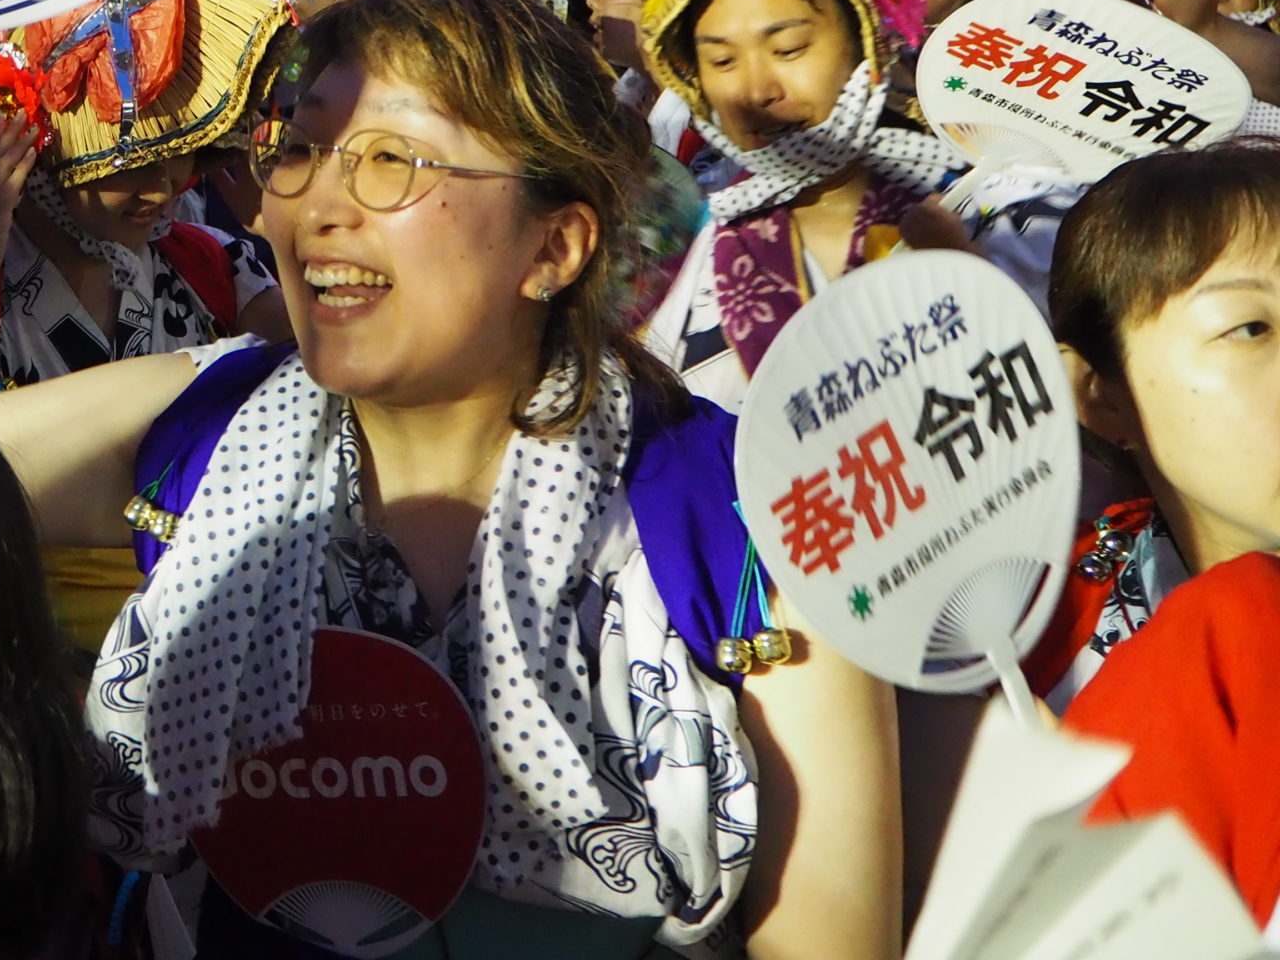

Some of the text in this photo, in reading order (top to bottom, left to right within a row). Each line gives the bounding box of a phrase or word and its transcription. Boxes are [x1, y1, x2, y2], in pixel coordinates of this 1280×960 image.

[945, 21, 1213, 145] 奉祝 令和
[1027, 8, 1210, 94] 青森ねぶた祭
[783, 293, 969, 442] 青森ねぶた祭
[771, 339, 1055, 577] 奉祝 令和
